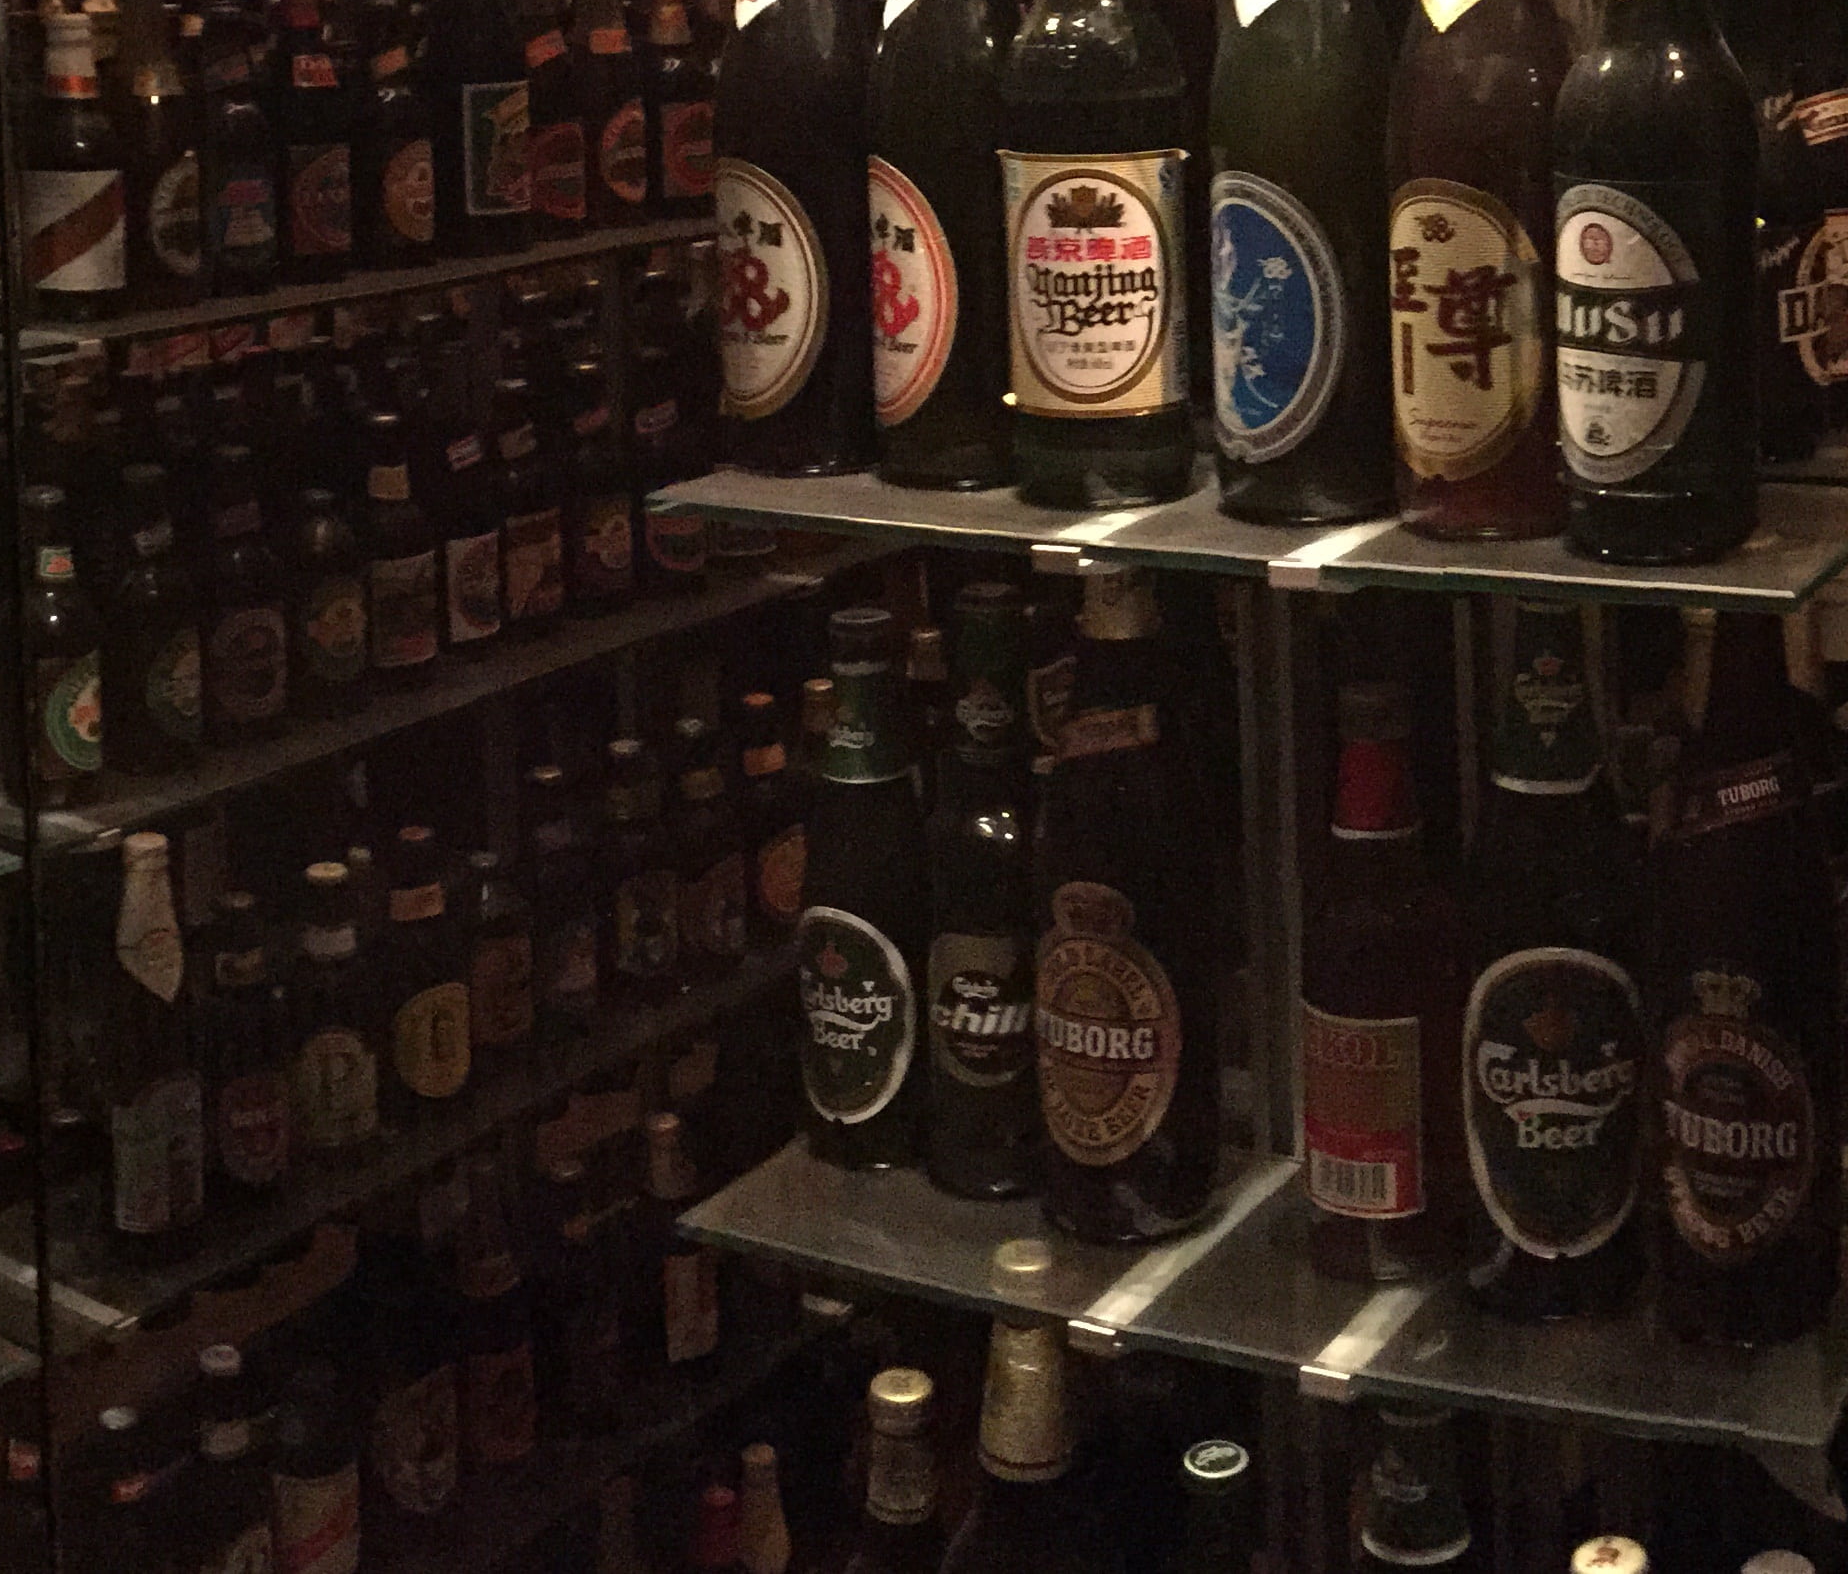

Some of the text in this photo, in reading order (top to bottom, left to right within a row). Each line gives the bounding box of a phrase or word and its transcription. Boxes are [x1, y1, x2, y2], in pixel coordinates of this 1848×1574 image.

[811, 1018, 866, 1051] Beer
[930, 1001, 1033, 1036] chill
[1475, 1038, 1636, 1108] Carlsberg
[1514, 1116, 1601, 1151] Beer
